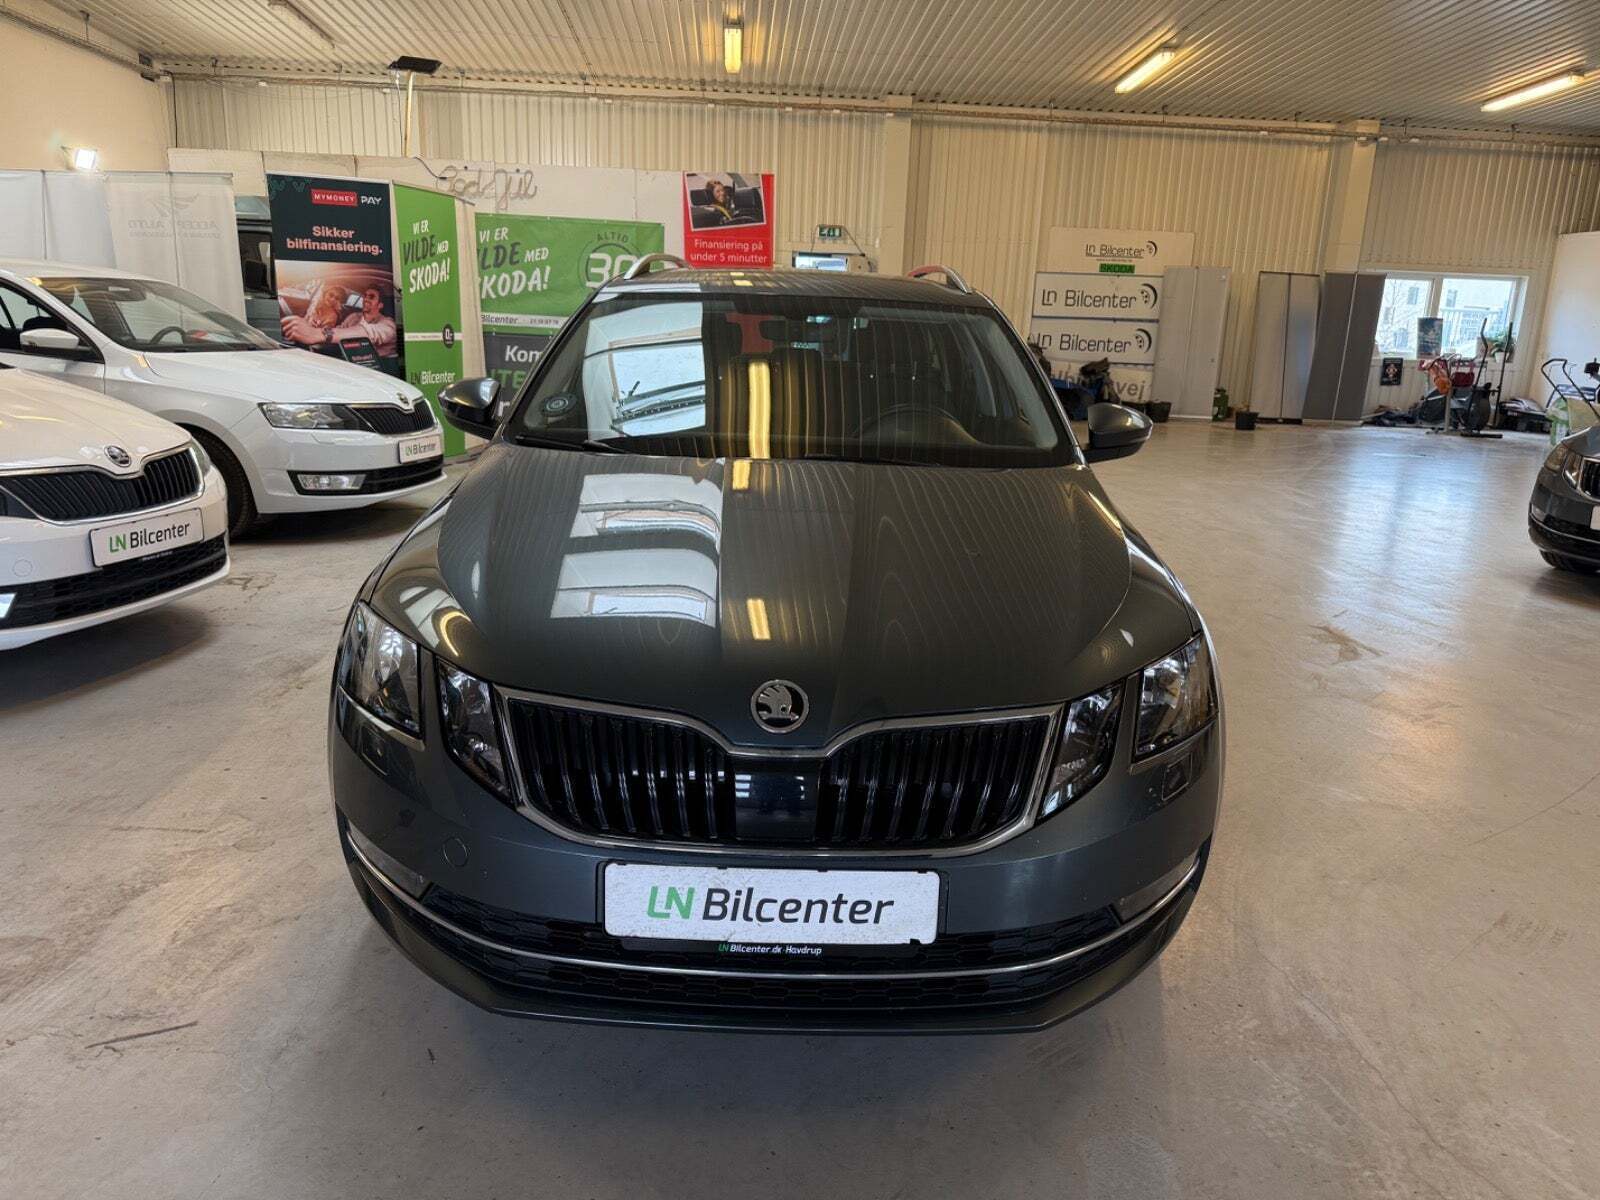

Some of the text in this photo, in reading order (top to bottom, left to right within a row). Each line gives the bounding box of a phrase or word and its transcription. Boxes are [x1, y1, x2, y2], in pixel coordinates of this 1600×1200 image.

[314, 193, 382, 205] MYMONEY PAY
[312, 226, 355, 238] Sikker
[412, 219, 429, 235] VI ER
[479, 226, 509, 243] VI ER
[596, 231, 629, 243] ALTID
[694, 238, 763, 252] Finansiering på
[286, 238, 383, 255] bilfinansiering.
[403, 234, 449, 265] VILDE MED
[1099, 243, 1145, 257] Bilcenter
[524, 247, 549, 263] MED
[690, 250, 768, 263] under 5 minutter
[409, 257, 450, 293] SKODA!
[481, 265, 551, 299] KODA!
[1064, 289, 1137, 309] Bilcenter
[1059, 333, 1132, 353] Bilcenter
[421, 371, 456, 385] Bilcenter
[109, 523, 190, 553] LN Bilcenter
[646, 885, 894, 924] LN Bilcenter
[785, 945, 822, 956] Havdrup
